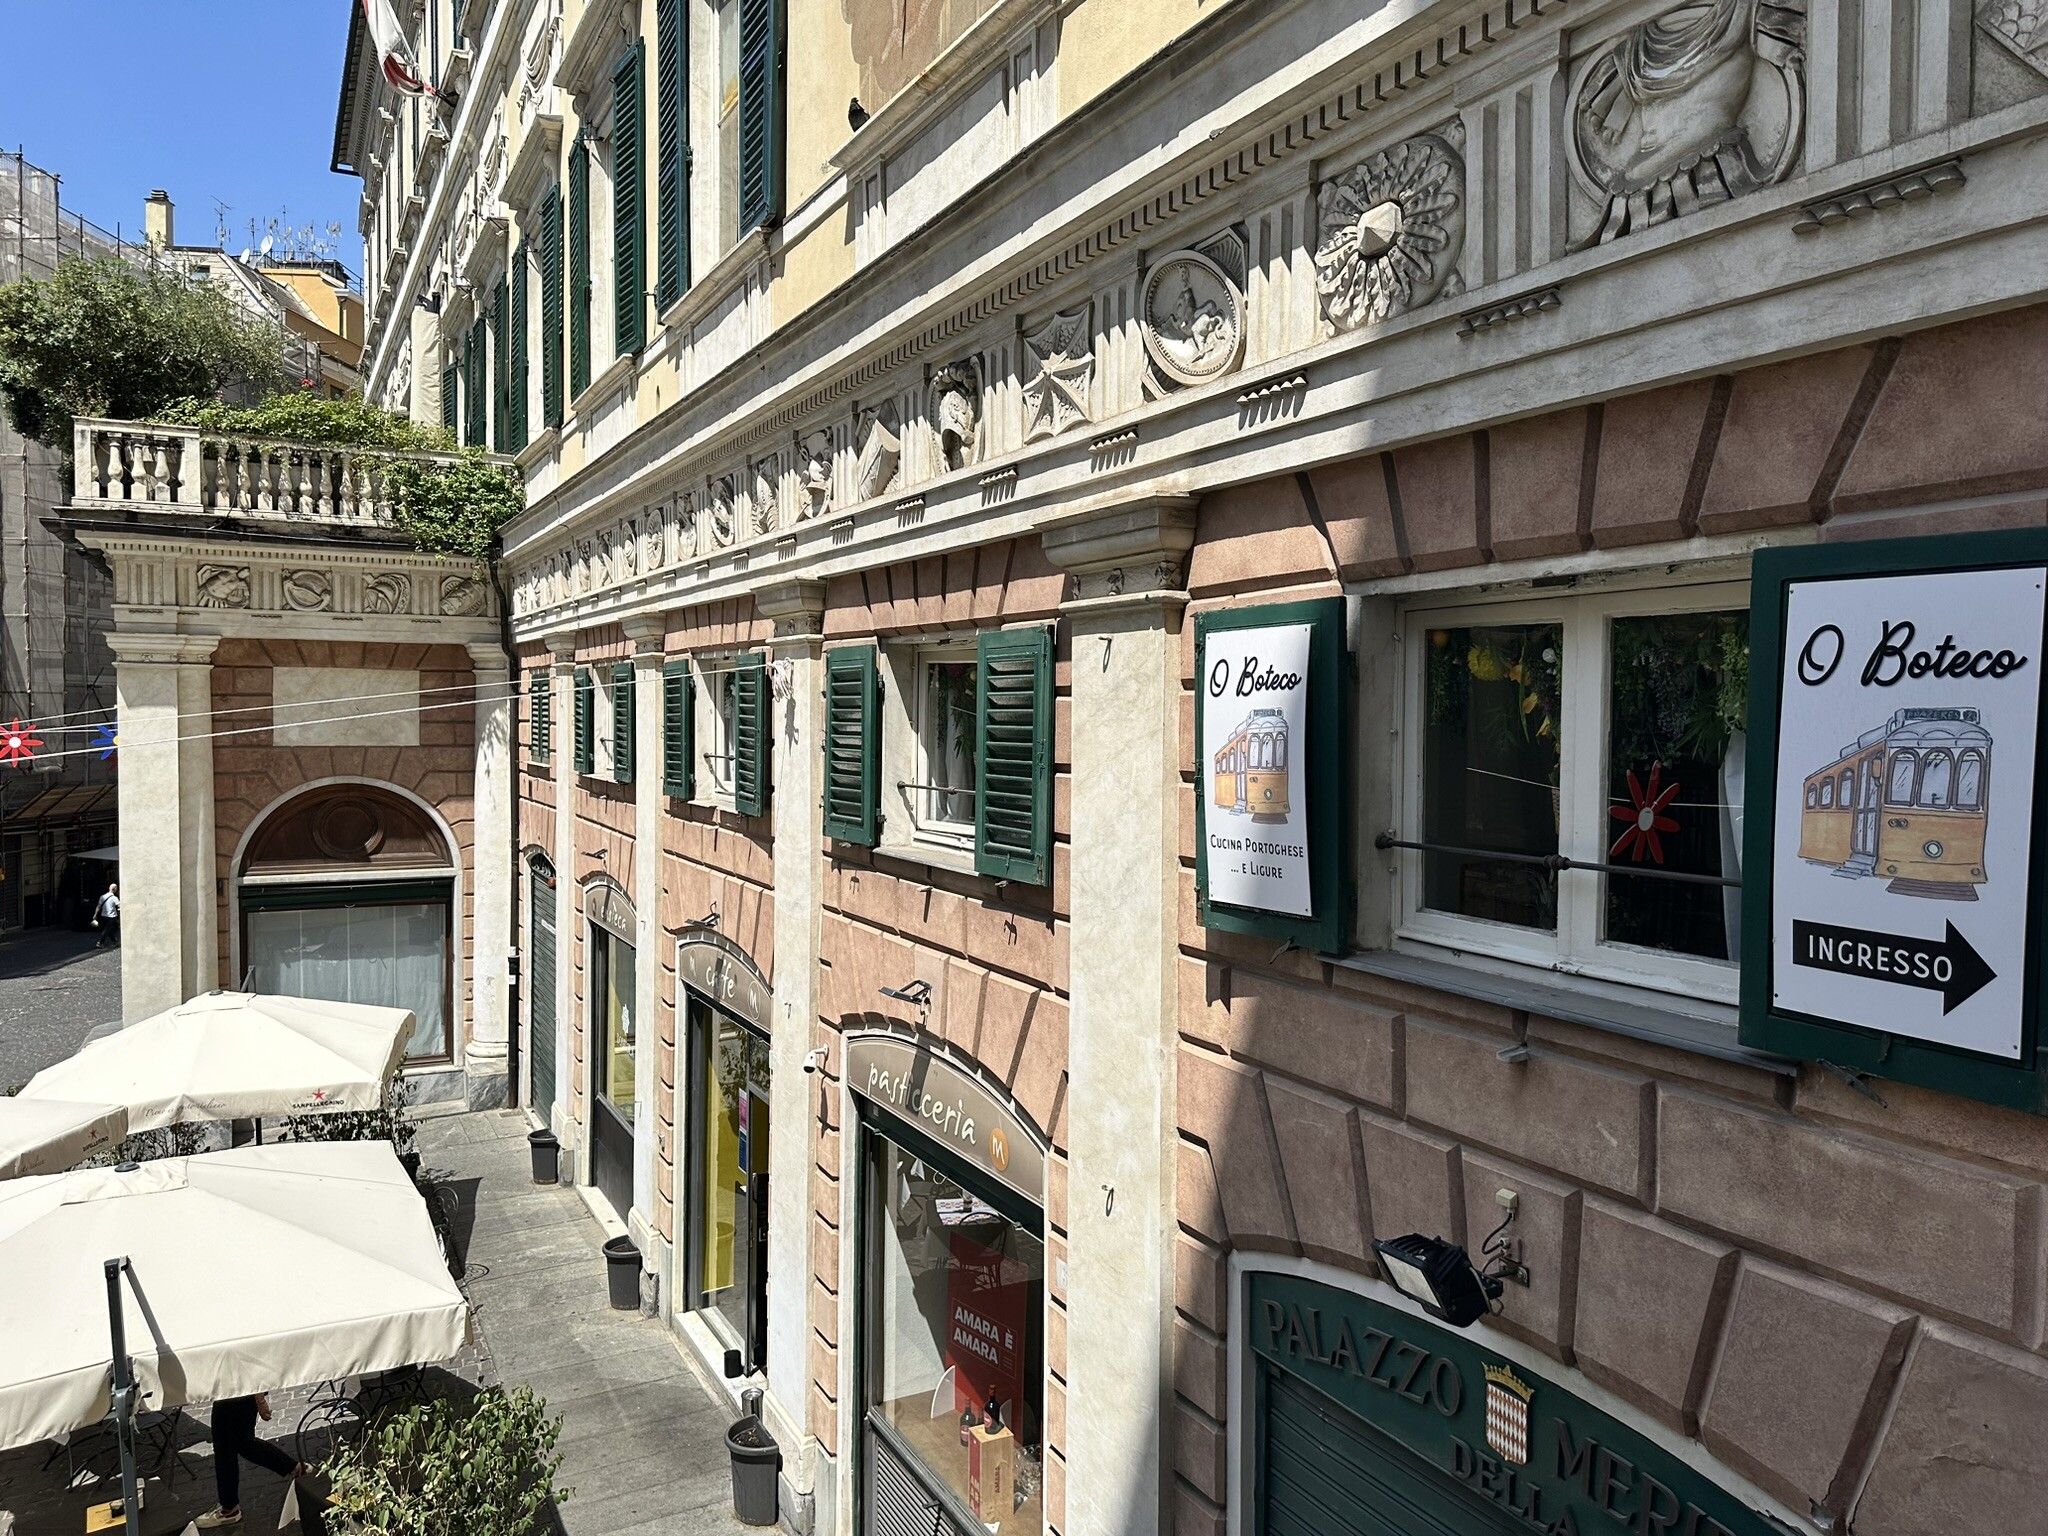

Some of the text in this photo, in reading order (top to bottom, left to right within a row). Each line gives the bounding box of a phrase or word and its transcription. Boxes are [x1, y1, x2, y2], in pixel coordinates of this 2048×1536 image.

[1798, 620, 2028, 687] O Boteco
[1210, 656, 1302, 698] O Boteco
[1210, 833, 1304, 858] CUCINA PORTOGHESE
[1250, 861, 1283, 879] LIGURE
[1808, 934, 1954, 983] INGRESSO
[953, 1328, 999, 1365] AMARA
[954, 1306, 1014, 1350] AMARA È
[1263, 1298, 1737, 1536] PALAZZO MER
